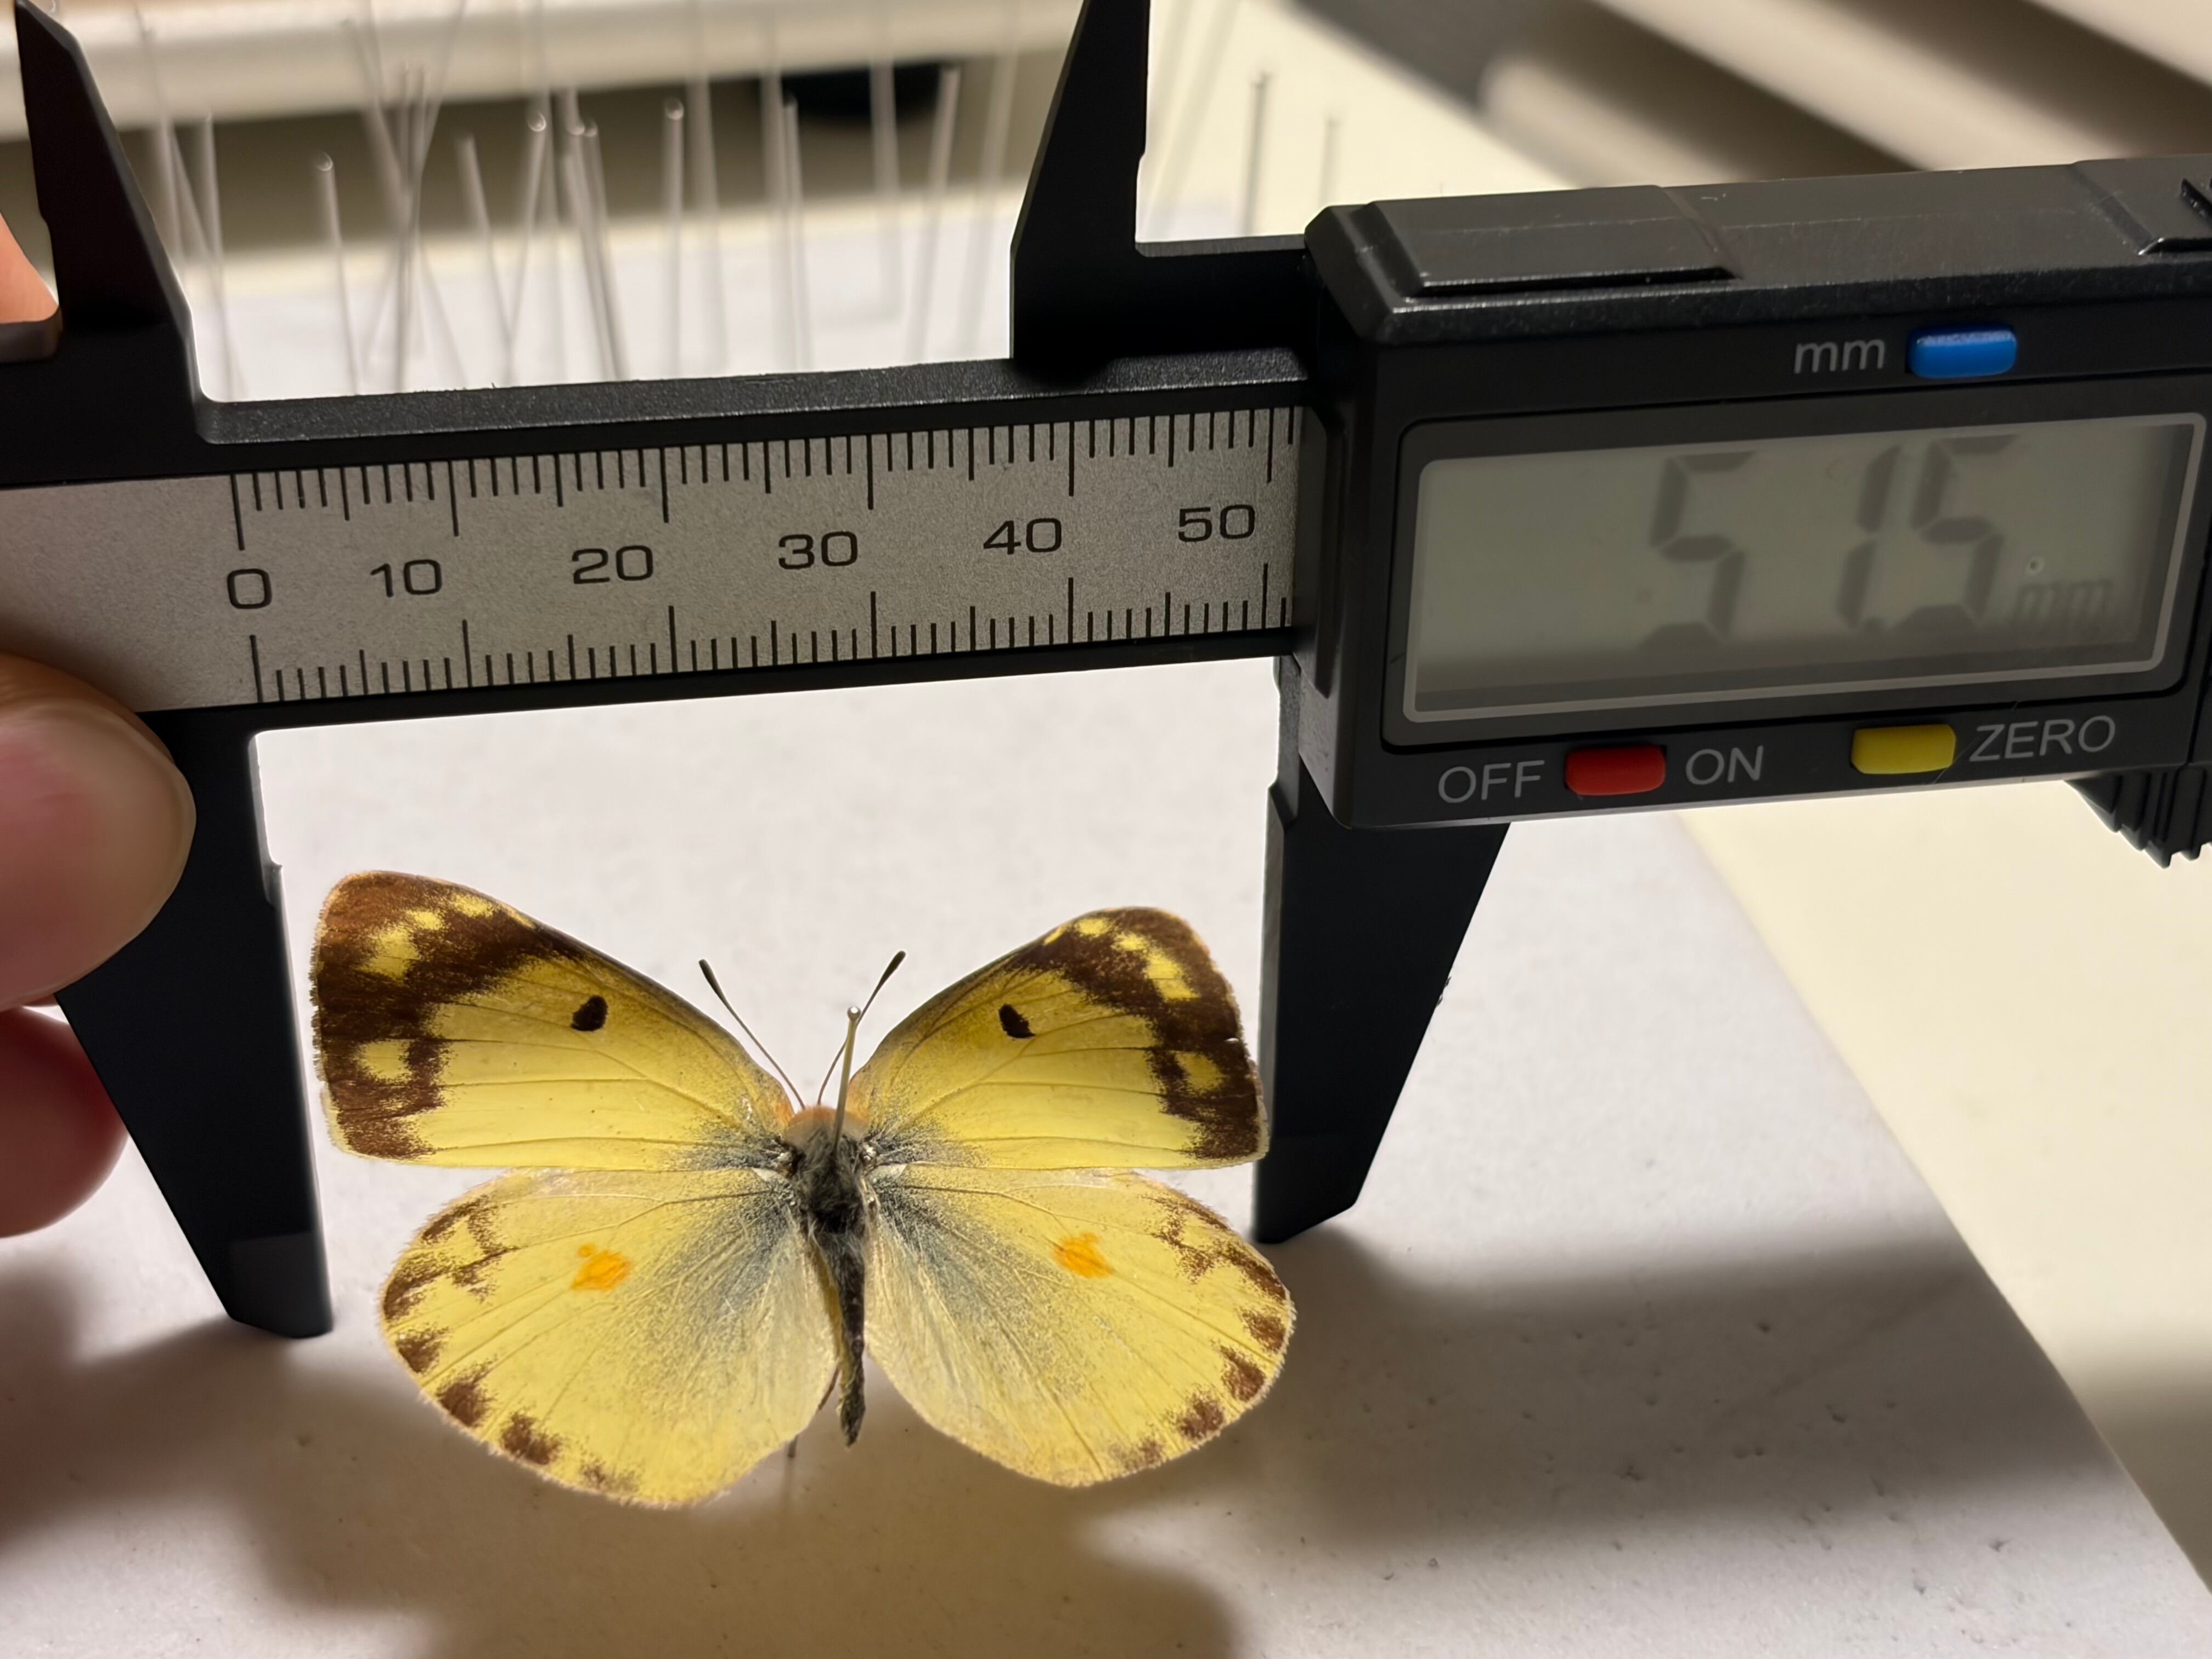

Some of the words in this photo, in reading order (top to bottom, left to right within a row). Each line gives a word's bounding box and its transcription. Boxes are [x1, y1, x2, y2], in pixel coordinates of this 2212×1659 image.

[1793, 338, 1885, 374] mm
[226, 568, 273, 610] 0
[370, 559, 442, 598] 10
[571, 545, 654, 585] 20
[777, 531, 859, 570] 30
[983, 517, 1063, 555] 40
[1177, 504, 1256, 543] 50
[1968, 714, 2117, 763] ZERO
[1437, 759, 1545, 804] OFF
[1685, 746, 1765, 786] ON
